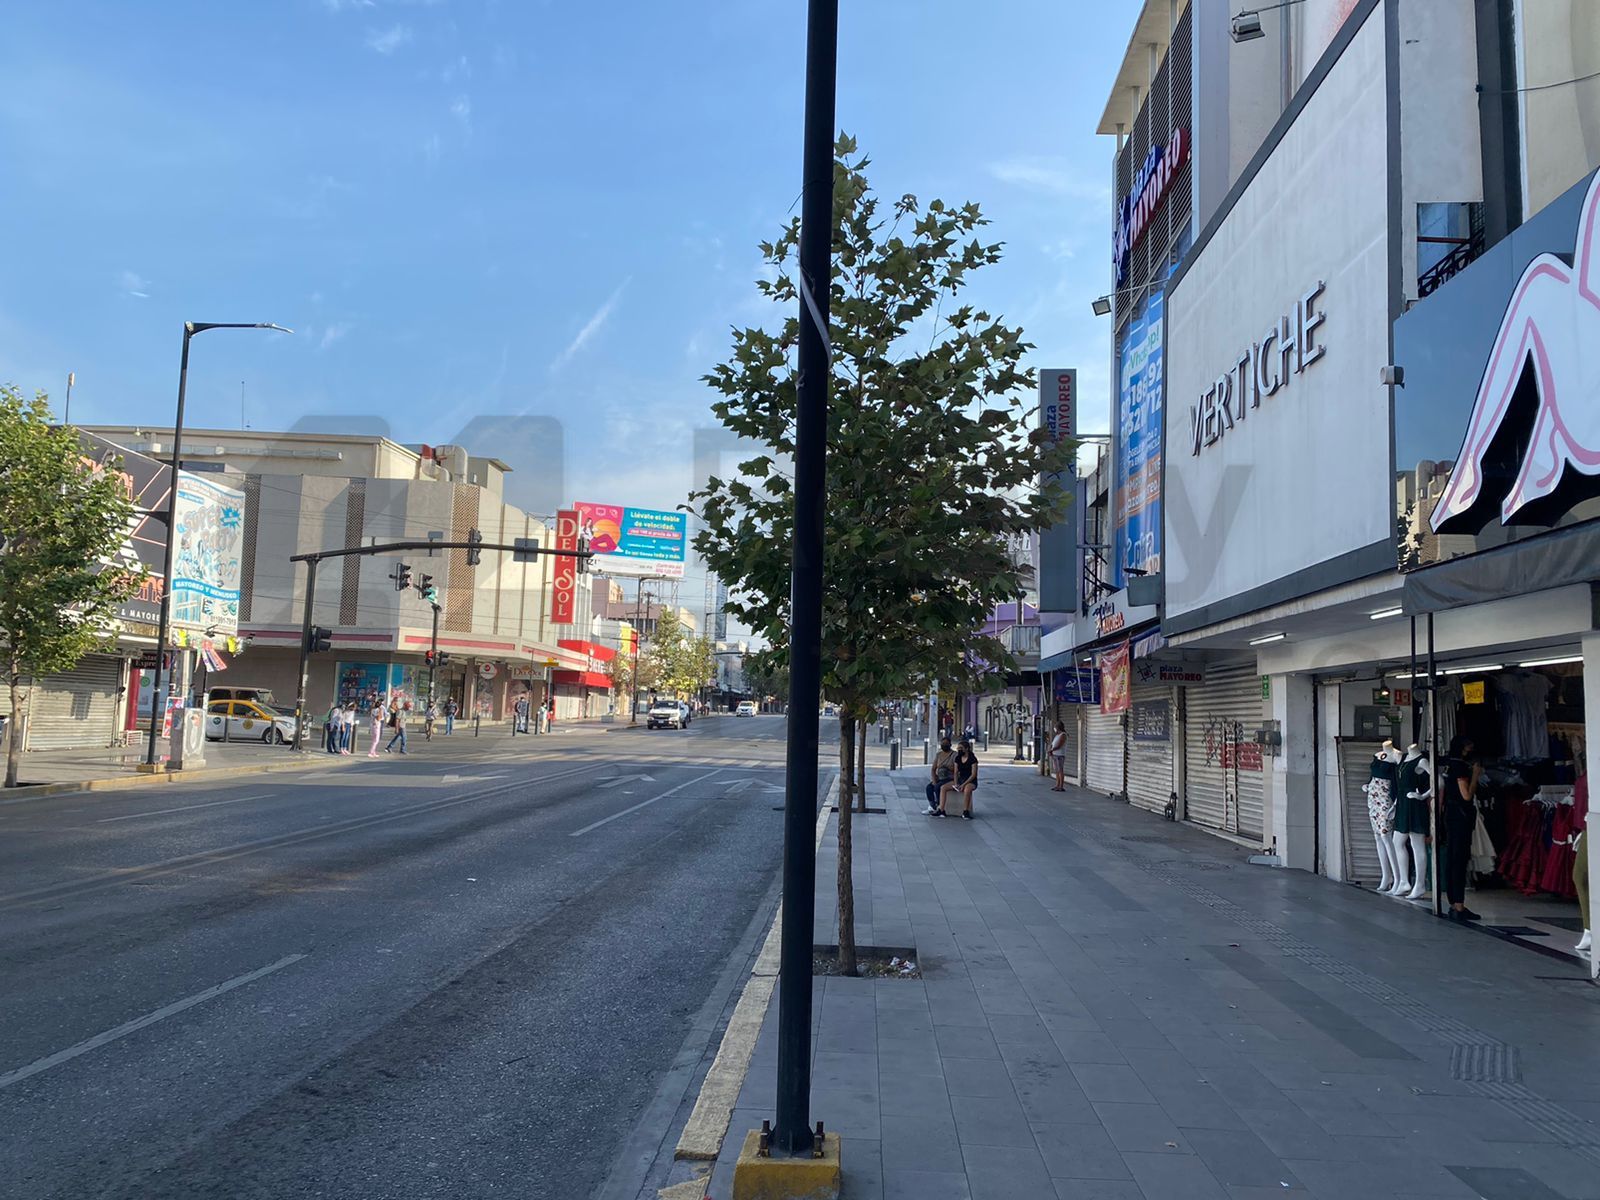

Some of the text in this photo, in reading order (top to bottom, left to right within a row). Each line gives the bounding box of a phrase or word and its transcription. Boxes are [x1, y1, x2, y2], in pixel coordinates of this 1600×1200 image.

[1130, 128, 1182, 249] MAYOREO
[1188, 281, 1327, 456] VERTICHE
[631, 511, 654, 520] Llévate
[554, 518, 577, 617] DEL SOL
[129, 609, 160, 622] MAYORE
[1160, 664, 1183, 672] plaza
[1160, 672, 1202, 681] MAYOREO
